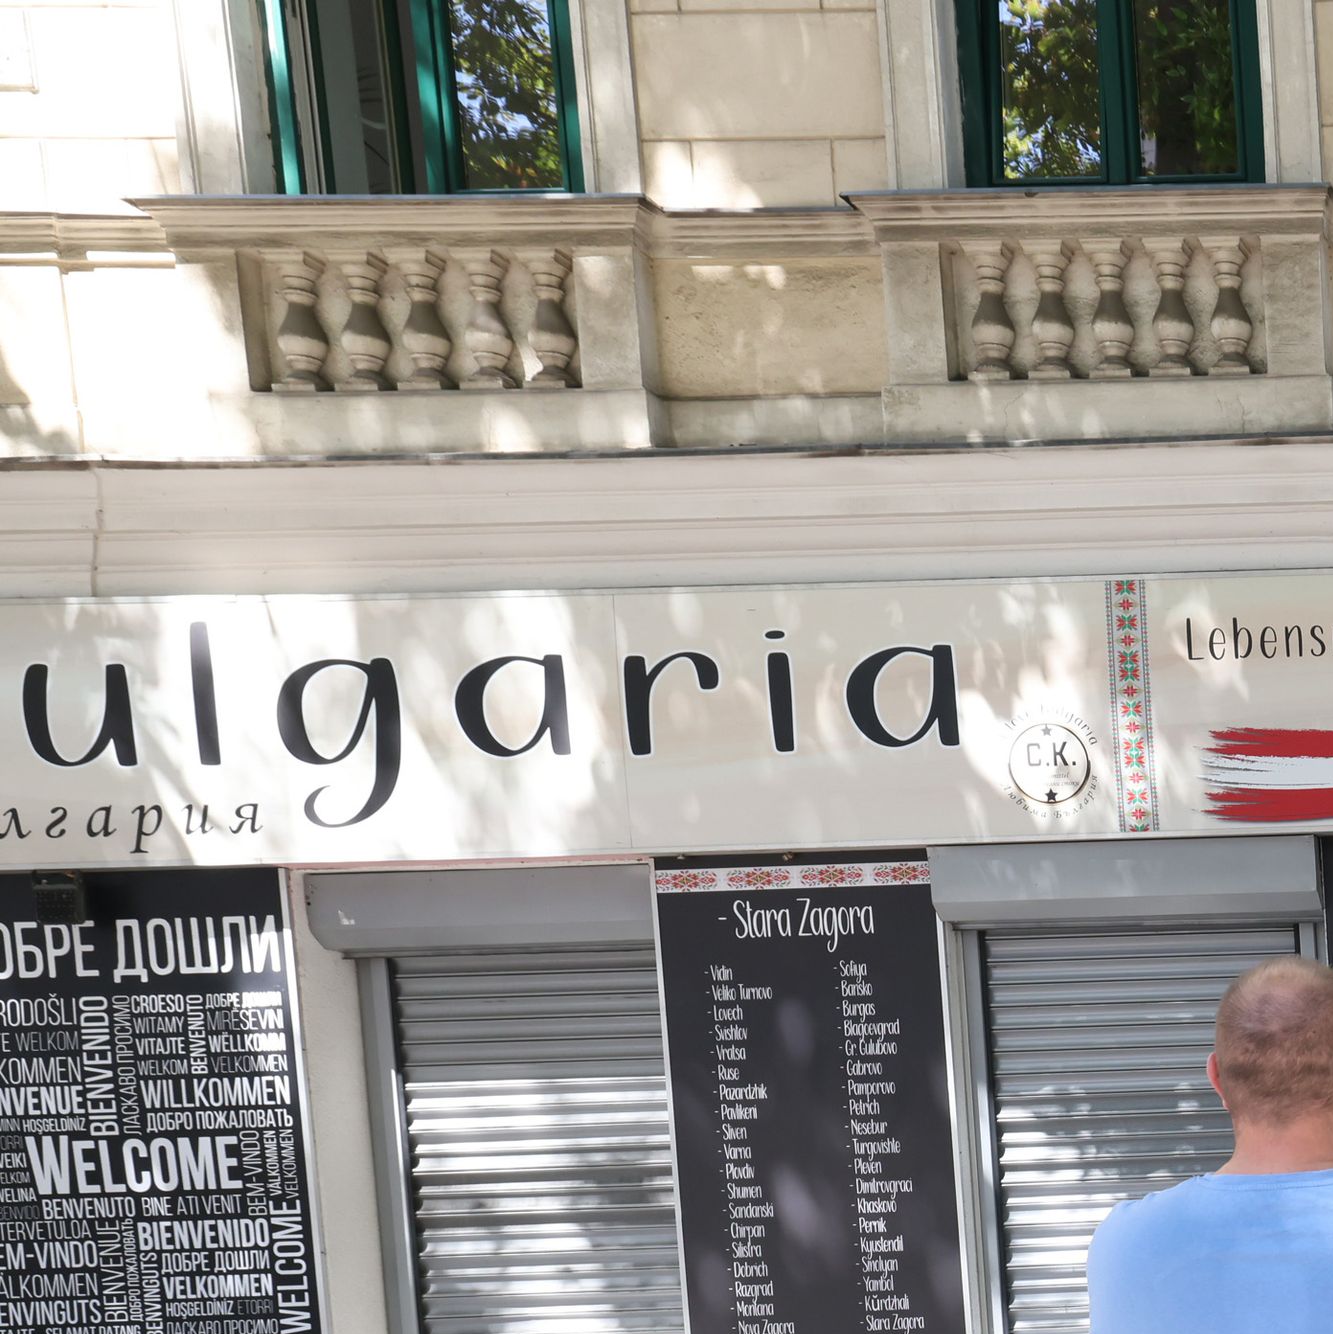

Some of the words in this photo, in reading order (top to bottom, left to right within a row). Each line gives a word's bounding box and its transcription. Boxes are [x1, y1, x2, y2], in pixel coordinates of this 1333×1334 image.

[22, 620, 960, 828] ulgaria
[1026, 741, 1076, 767] C.K.
[0, 803, 263, 854] лгария
[733, 899, 791, 939] Stara
[796, 898, 874, 953] Zagora
[113, 914, 282, 983] ДОШЛИ
[710, 965, 733, 981] Vidin
[839, 959, 867, 983] Sofiya
[711, 984, 737, 1001] Veliko
[738, 983, 773, 1000] Turnovo
[841, 980, 873, 997] Bansko
[131, 993, 185, 1014] CROESO
[205, 993, 241, 1010] ДОБРЕ
[842, 999, 876, 1022] Burgas
[713, 1004, 743, 1021] Lovech
[112, 995, 135, 1063] ПРОСИМО
[133, 1016, 185, 1034] WITAMY
[186, 994, 208, 1074] BENVENUTO
[715, 1024, 748, 1041] Svishtov
[844, 1019, 900, 1042] Blagoevgrad
[15, 1031, 79, 1052] WELKOM
[135, 1037, 186, 1055] VITAJTE
[716, 1045, 746, 1061] Vratsa
[79, 995, 120, 1136] BIENVENIDO
[137, 1059, 188, 1076] WELKOM
[211, 1054, 288, 1074] VELKOMMEN
[718, 1064, 740, 1081] Ruse
[846, 1059, 882, 1076] Gabrovo
[117, 1066, 142, 1135] ЛАСКАВО
[140, 1075, 292, 1109] WILLKOMMEN
[719, 1083, 768, 1100] Pazardzhik
[847, 1079, 896, 1101] Pamporovo
[720, 1103, 758, 1120] Pavlikeni
[849, 1099, 880, 1116] Petrich
[146, 1112, 193, 1134] ДОБРО
[195, 1108, 294, 1130] ПОЖАЛОВАТЬ
[722, 1123, 747, 1140] Sliven
[851, 1119, 888, 1135] Nesebur
[723, 1143, 752, 1160] Varna
[852, 1137, 901, 1161] Turgovishte
[24, 1134, 244, 1195] WELCOME
[239, 1130, 268, 1216] BEM-VINDO
[280, 1128, 299, 1199] VELKOMMEN
[725, 1163, 755, 1179] Plovdiv
[854, 1158, 882, 1175] Pleven
[727, 1183, 762, 1199] Shumen
[42, 1196, 136, 1220] BENVENUTO
[141, 1197, 173, 1217] BINE
[177, 1196, 199, 1216] ATI
[202, 1194, 242, 1215] VENIT
[728, 1202, 774, 1219] Sandanski
[857, 1197, 897, 1214] Khaskovo
[0, 1220, 92, 1241] TERVETULOA
[137, 1218, 270, 1250] BIENVENIDO
[730, 1222, 765, 1243] Chirpan
[859, 1217, 887, 1234] Pernik
[731, 1241, 762, 1258] Silistra
[860, 1235, 904, 1259] Kyustendil
[95, 1219, 129, 1322] BIENVENUE
[161, 1252, 210, 1274] ДОБРЕ
[213, 1250, 270, 1272] ДОШЛИ
[269, 1199, 312, 1334] WELCOME
[733, 1261, 768, 1278] Dobrich
[861, 1256, 898, 1279] Smolyan
[162, 1274, 273, 1300] VELKOMMEN
[735, 1280, 773, 1302] Razgrad
[863, 1275, 895, 1292] Yambol
[128, 1288, 144, 1322] ДОБРО
[736, 1300, 774, 1317] Montana
[866, 1314, 891, 1331] Stara
